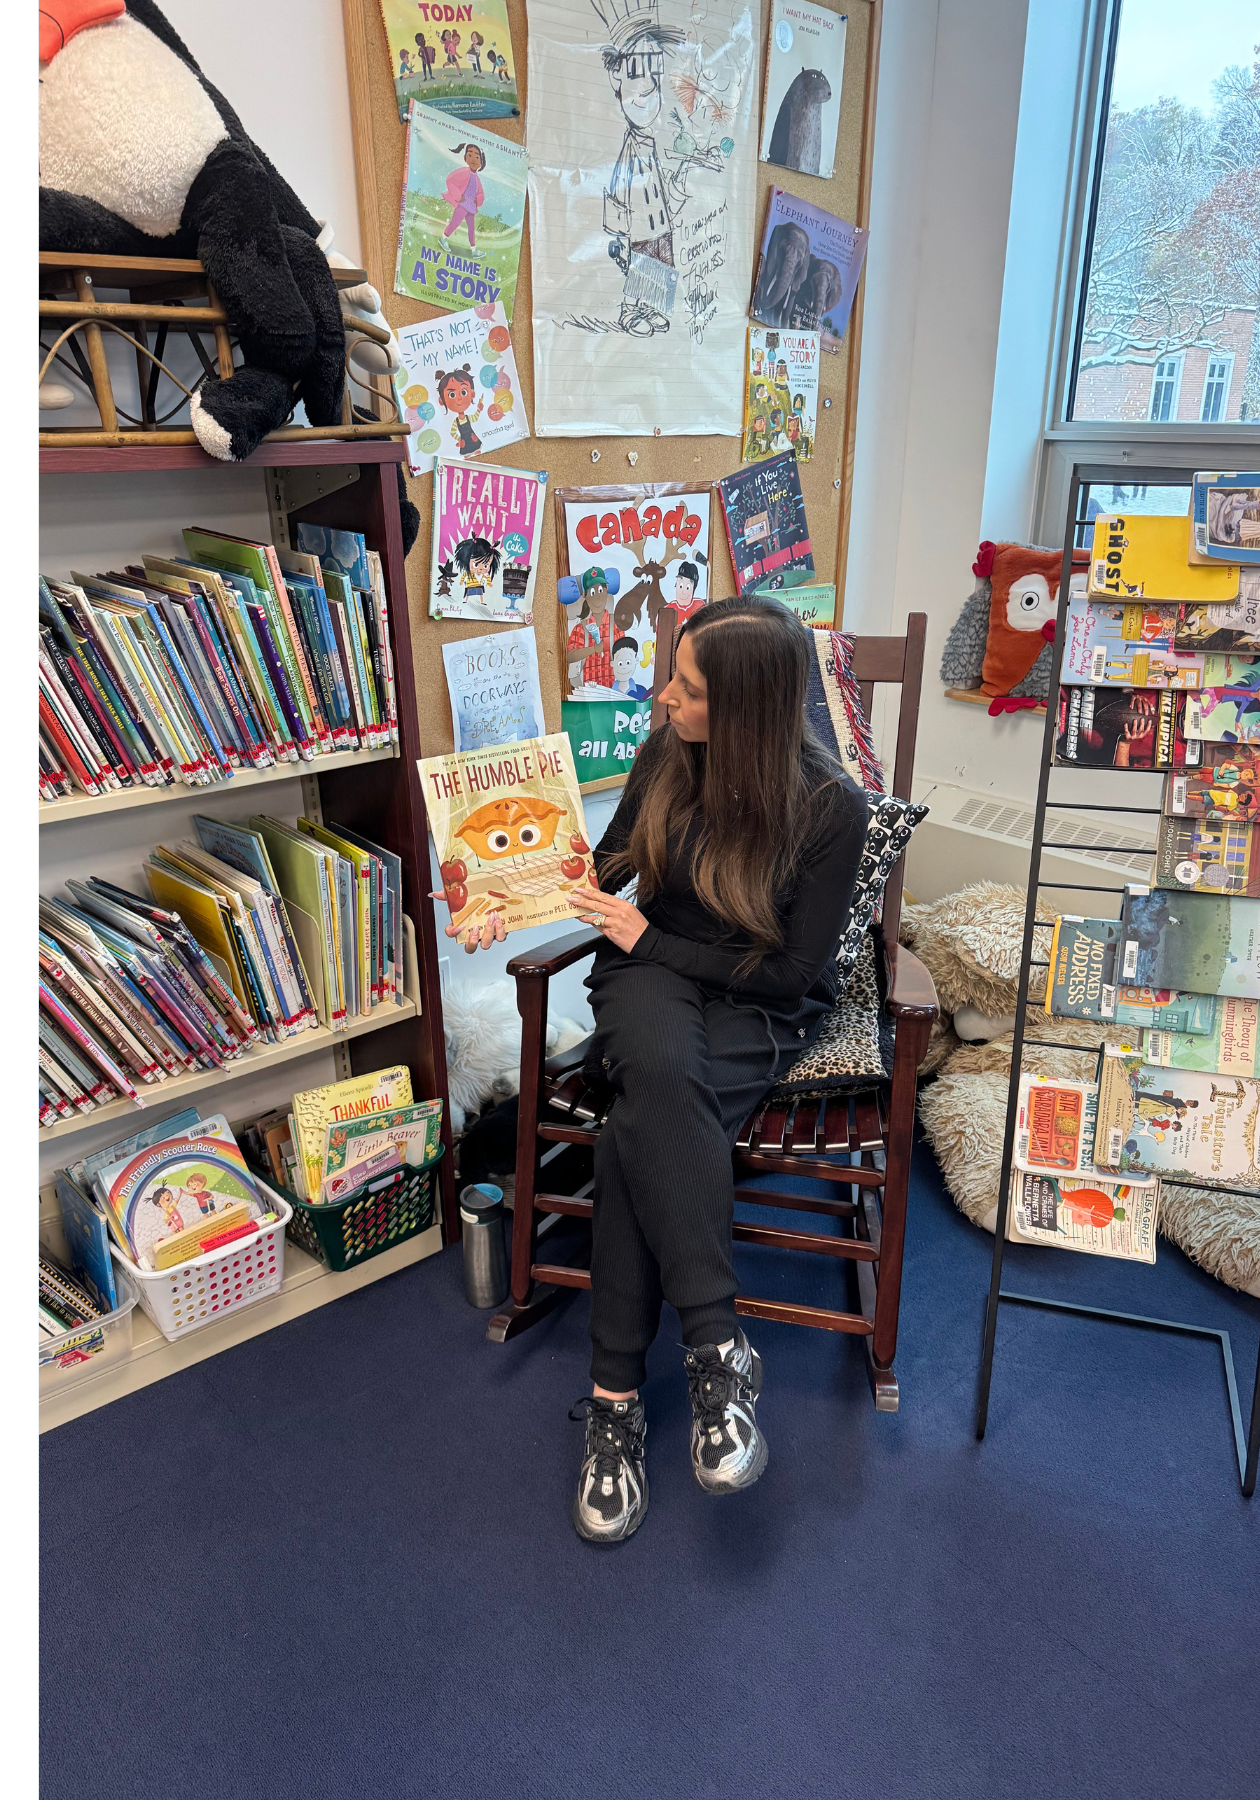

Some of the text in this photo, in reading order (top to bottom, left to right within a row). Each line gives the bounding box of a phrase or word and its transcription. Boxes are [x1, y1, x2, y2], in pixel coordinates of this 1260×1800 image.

[418, 3, 473, 22] TODAY
[782, 6, 835, 31] I WANT MY HAT BACK
[415, 111, 438, 124] GRAMMY
[479, 136, 495, 147] ARTIST
[775, 199, 821, 230] ELEPHANT
[820, 221, 859, 248] JOURNEY
[420, 246, 498, 282] MY NAME IS
[411, 260, 427, 285] A
[435, 268, 501, 304] STORY
[420, 289, 451, 303] ILLUSTRATED
[404, 318, 472, 352] THAT'S NOT
[783, 337, 817, 350] YOU ARE A
[422, 337, 479, 367] MY NAME!
[789, 350, 817, 363] STORY
[754, 470, 778, 487] If You
[760, 481, 778, 495] Live
[441, 466, 537, 526] I REALLY
[767, 488, 788, 504] Here
[457, 504, 509, 533] WANT
[576, 505, 702, 553] Canada
[505, 540, 526, 554] Cake
[512, 533, 521, 542] the
[1105, 518, 1125, 593] GHOST
[1083, 616, 1097, 637] One
[48, 637, 74, 682] THE STRANGER
[287, 612, 295, 628] THE
[291, 629, 308, 674] VELVETEEN
[304, 674, 315, 699] RABBIT
[373, 648, 381, 675] TUESDAY
[465, 645, 518, 676] BOOKS
[1068, 636, 1082, 669] Lama
[1075, 649, 1093, 676] Only
[82, 657, 92, 671] TREE
[89, 670, 101, 688] HOUSE
[99, 687, 110, 702] THAT
[106, 701, 116, 716] JACK
[114, 715, 125, 730] BUILT
[215, 666, 240, 717] Bear Snores On
[257, 657, 281, 713] Bear Wants More
[463, 680, 527, 709] DOORWAYS
[54, 720, 67, 740] AFRICA
[471, 705, 526, 739] DREAMS
[1065, 689, 1082, 760] CHANGERS
[578, 740, 608, 758] all
[1157, 718, 1170, 764] LUPICA
[430, 750, 563, 799] THE HUMBLE PIE
[1164, 818, 1174, 875] ZIPORAH COHEN
[270, 902, 278, 925] Wilson
[507, 914, 524, 924] JOHN
[554, 904, 568, 914] PETE
[79, 949, 91, 962] WOOD
[276, 957, 282, 968] MY
[1067, 930, 1092, 1006] ADDRESS
[1086, 939, 1105, 1001] NO FIXED
[278, 967, 289, 984] HEART
[69, 986, 117, 1040] YOU'RE FINALLY HERE!
[94, 996, 126, 1031] OLD COYOTE
[1240, 1014, 1257, 1063] Theory of
[340, 1084, 374, 1097] Eileen Spinelli
[1059, 1094, 1078, 1113] GITA
[329, 1094, 392, 1121] THANKFUL
[1031, 1091, 1052, 1152] VARADARAJAN
[1226, 1101, 1235, 1118] The
[1080, 1092, 1099, 1174] SAVE ME A SEAT
[1200, 1113, 1213, 1143] Tale
[352, 1131, 421, 1158] The Little Beaver
[119, 1143, 217, 1197] The Friendly Scooter Race
[352, 1170, 367, 1181] Cleo
[353, 1163, 388, 1185] Cooperates
[1024, 1175, 1033, 1226] WALLFLOWER
[1032, 1182, 1040, 1222] BERNETTA
[1041, 1219, 1048, 1228] OF
[1141, 1193, 1153, 1249] LISA GRAFF
[50, 1298, 60, 1310] like
